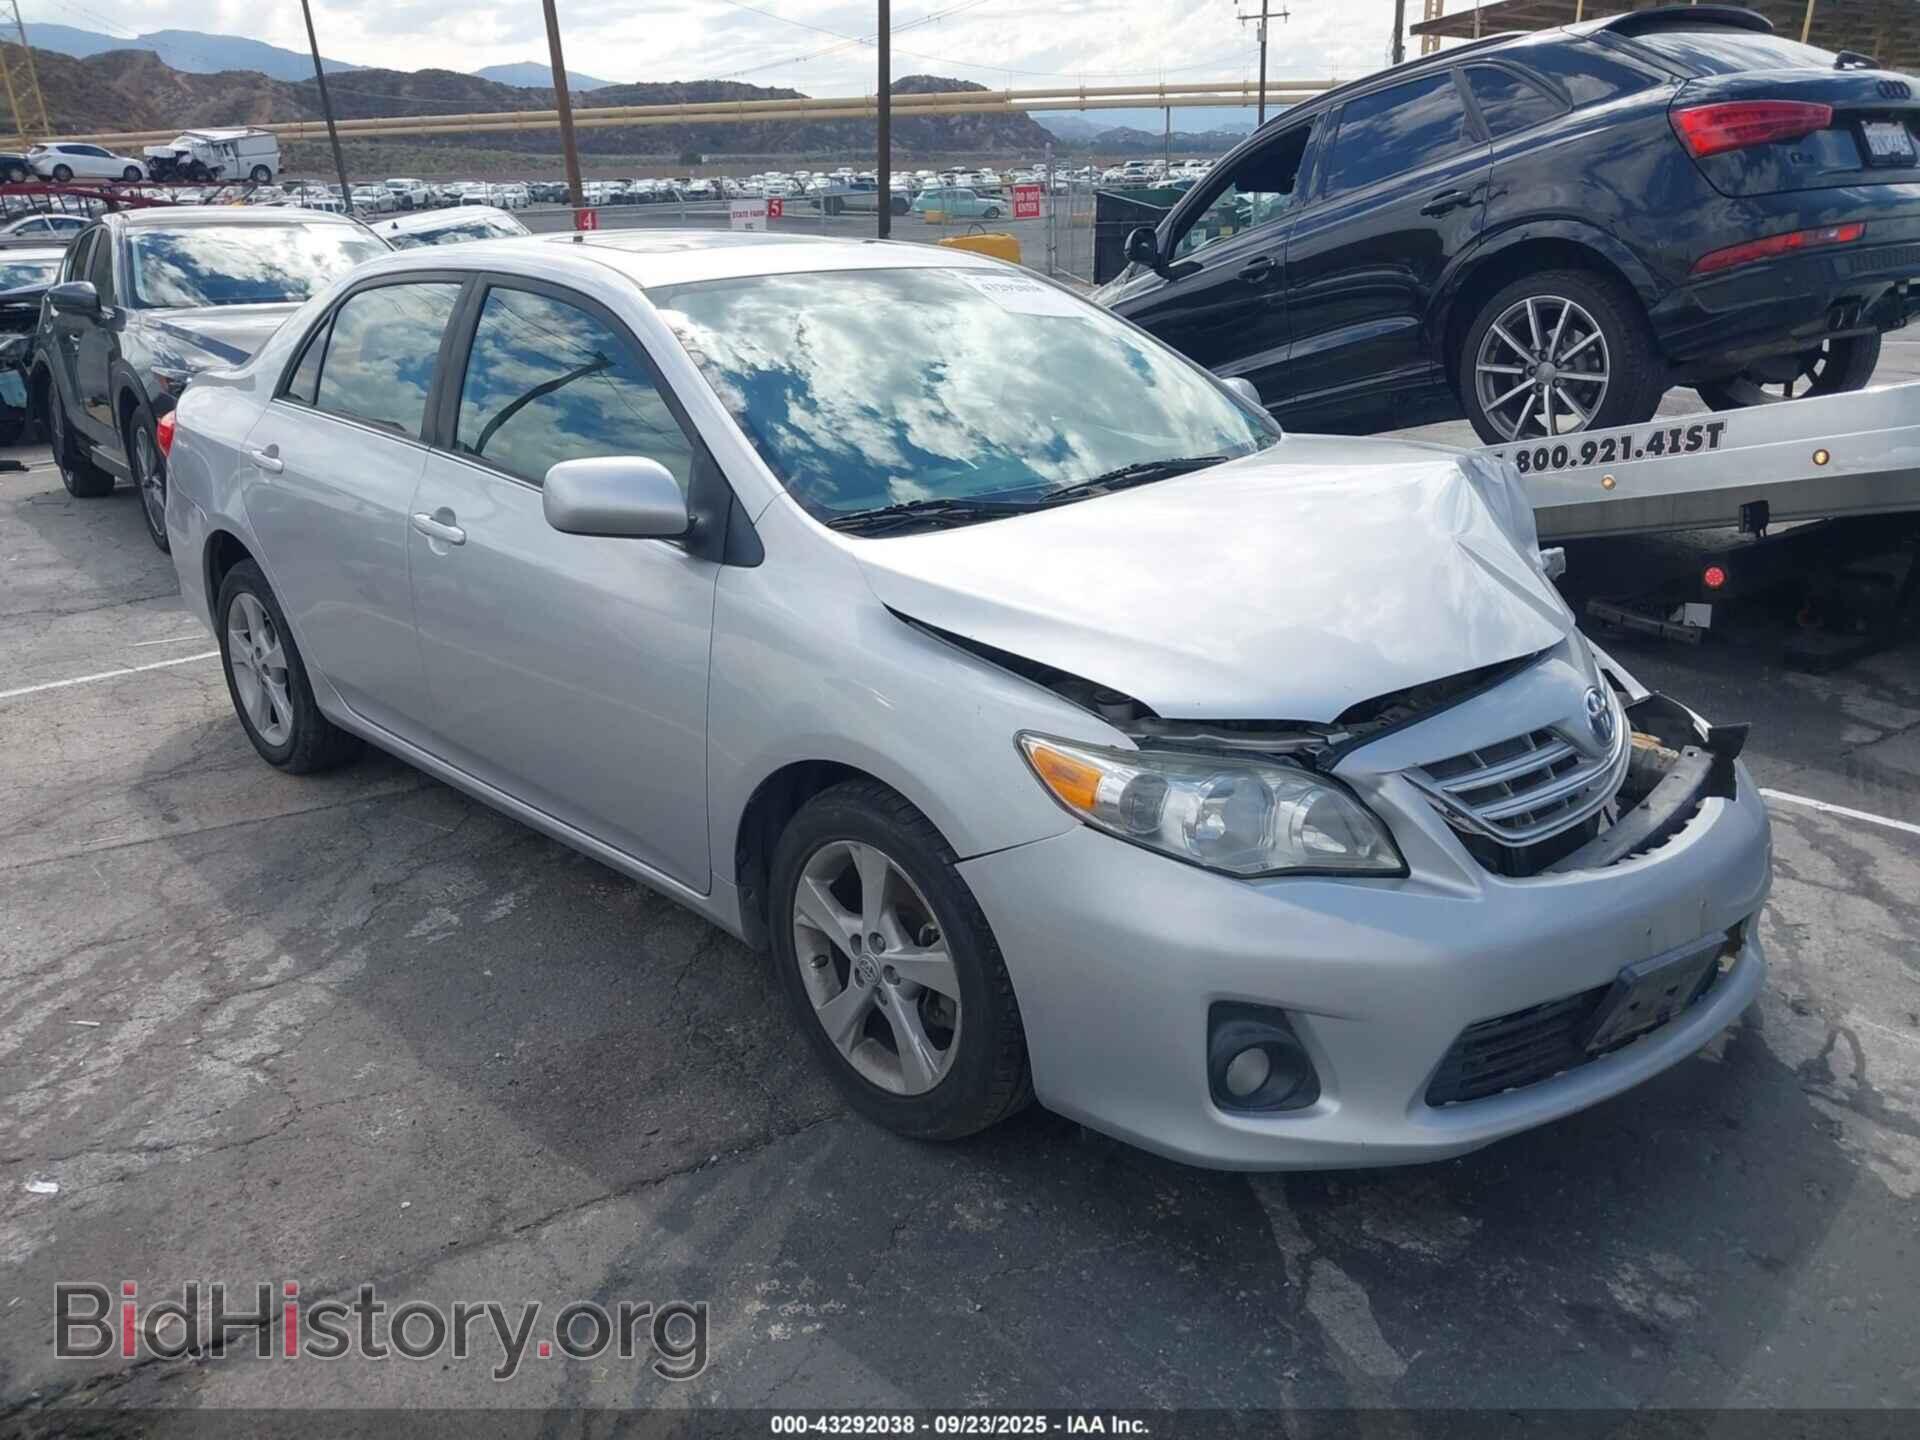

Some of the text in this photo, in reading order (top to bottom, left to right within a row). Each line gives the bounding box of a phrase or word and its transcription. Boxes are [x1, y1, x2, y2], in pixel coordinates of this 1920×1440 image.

[771, 199, 780, 216] 5
[583, 213, 593, 229] 4
[1494, 422, 1724, 474] 800.921.4IST
